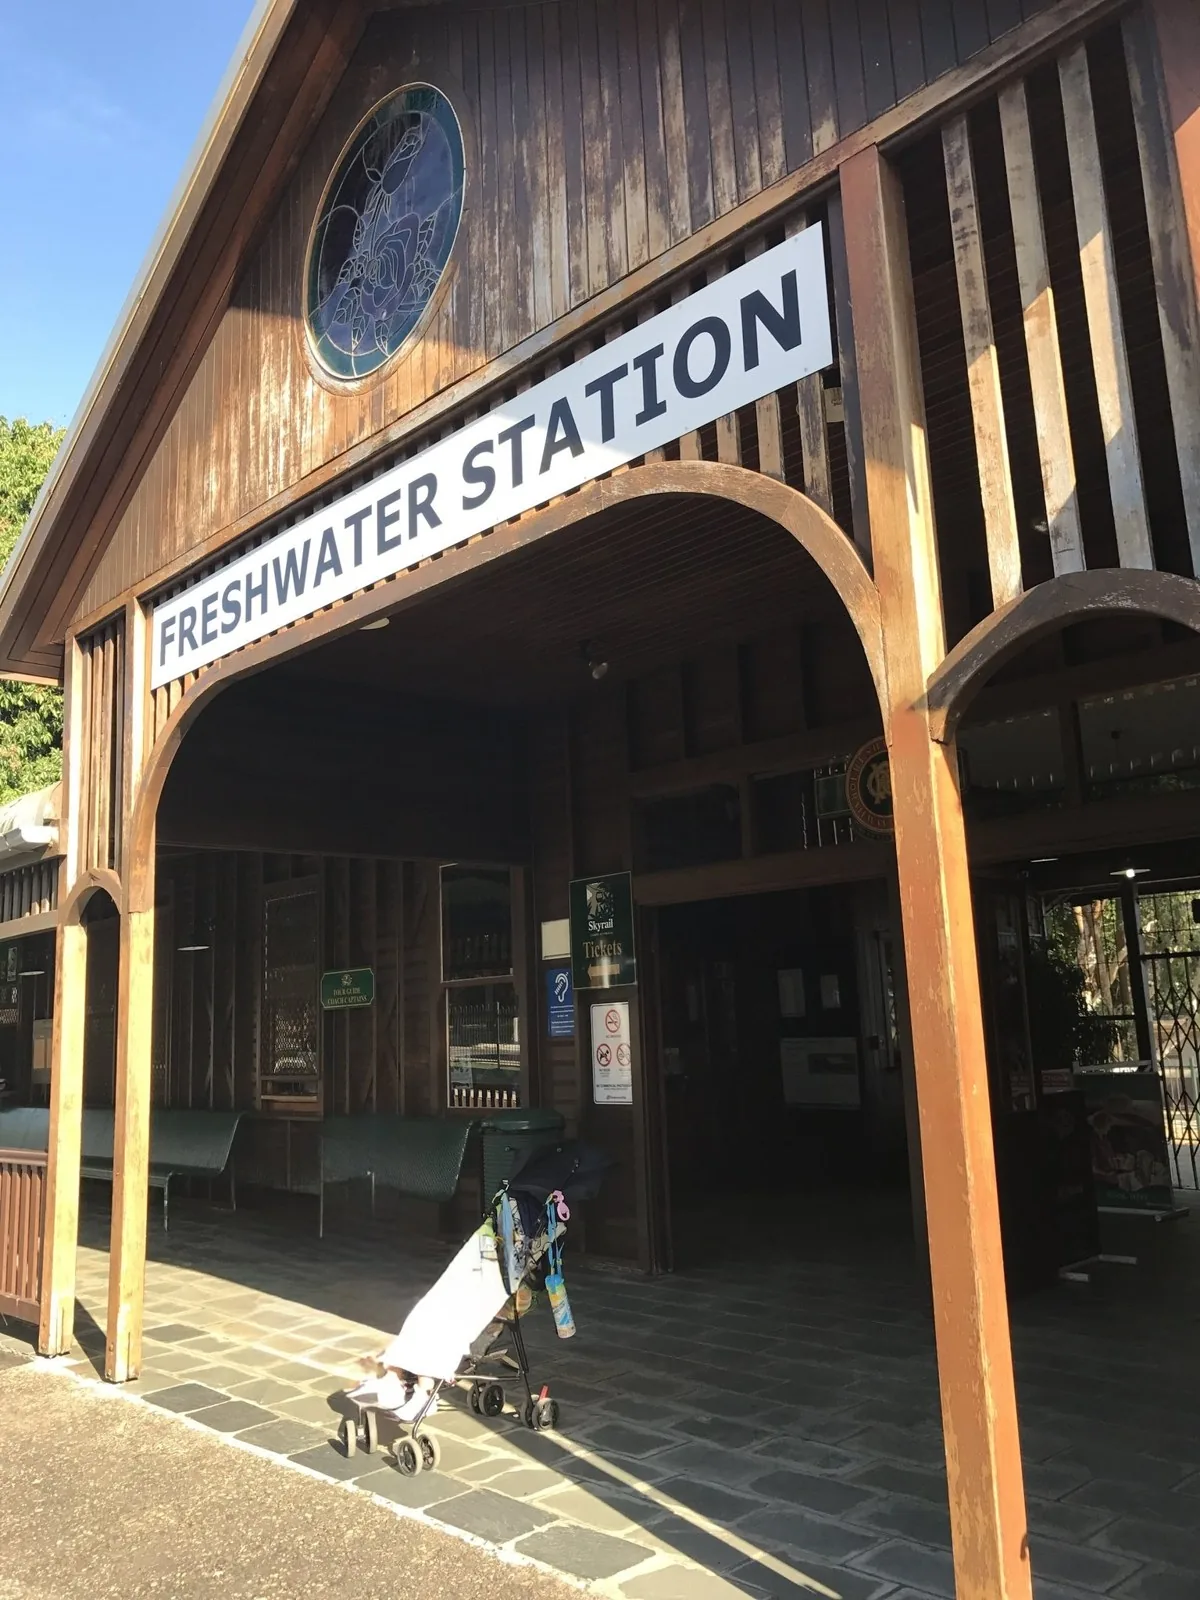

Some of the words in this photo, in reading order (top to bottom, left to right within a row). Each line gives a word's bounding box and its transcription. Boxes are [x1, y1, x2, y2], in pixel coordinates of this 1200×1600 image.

[158, 472, 443, 667] FRESHWATER
[461, 268, 803, 511] STATION
[588, 918, 614, 932] Skyrail
[582, 939, 623, 959] Tickets
